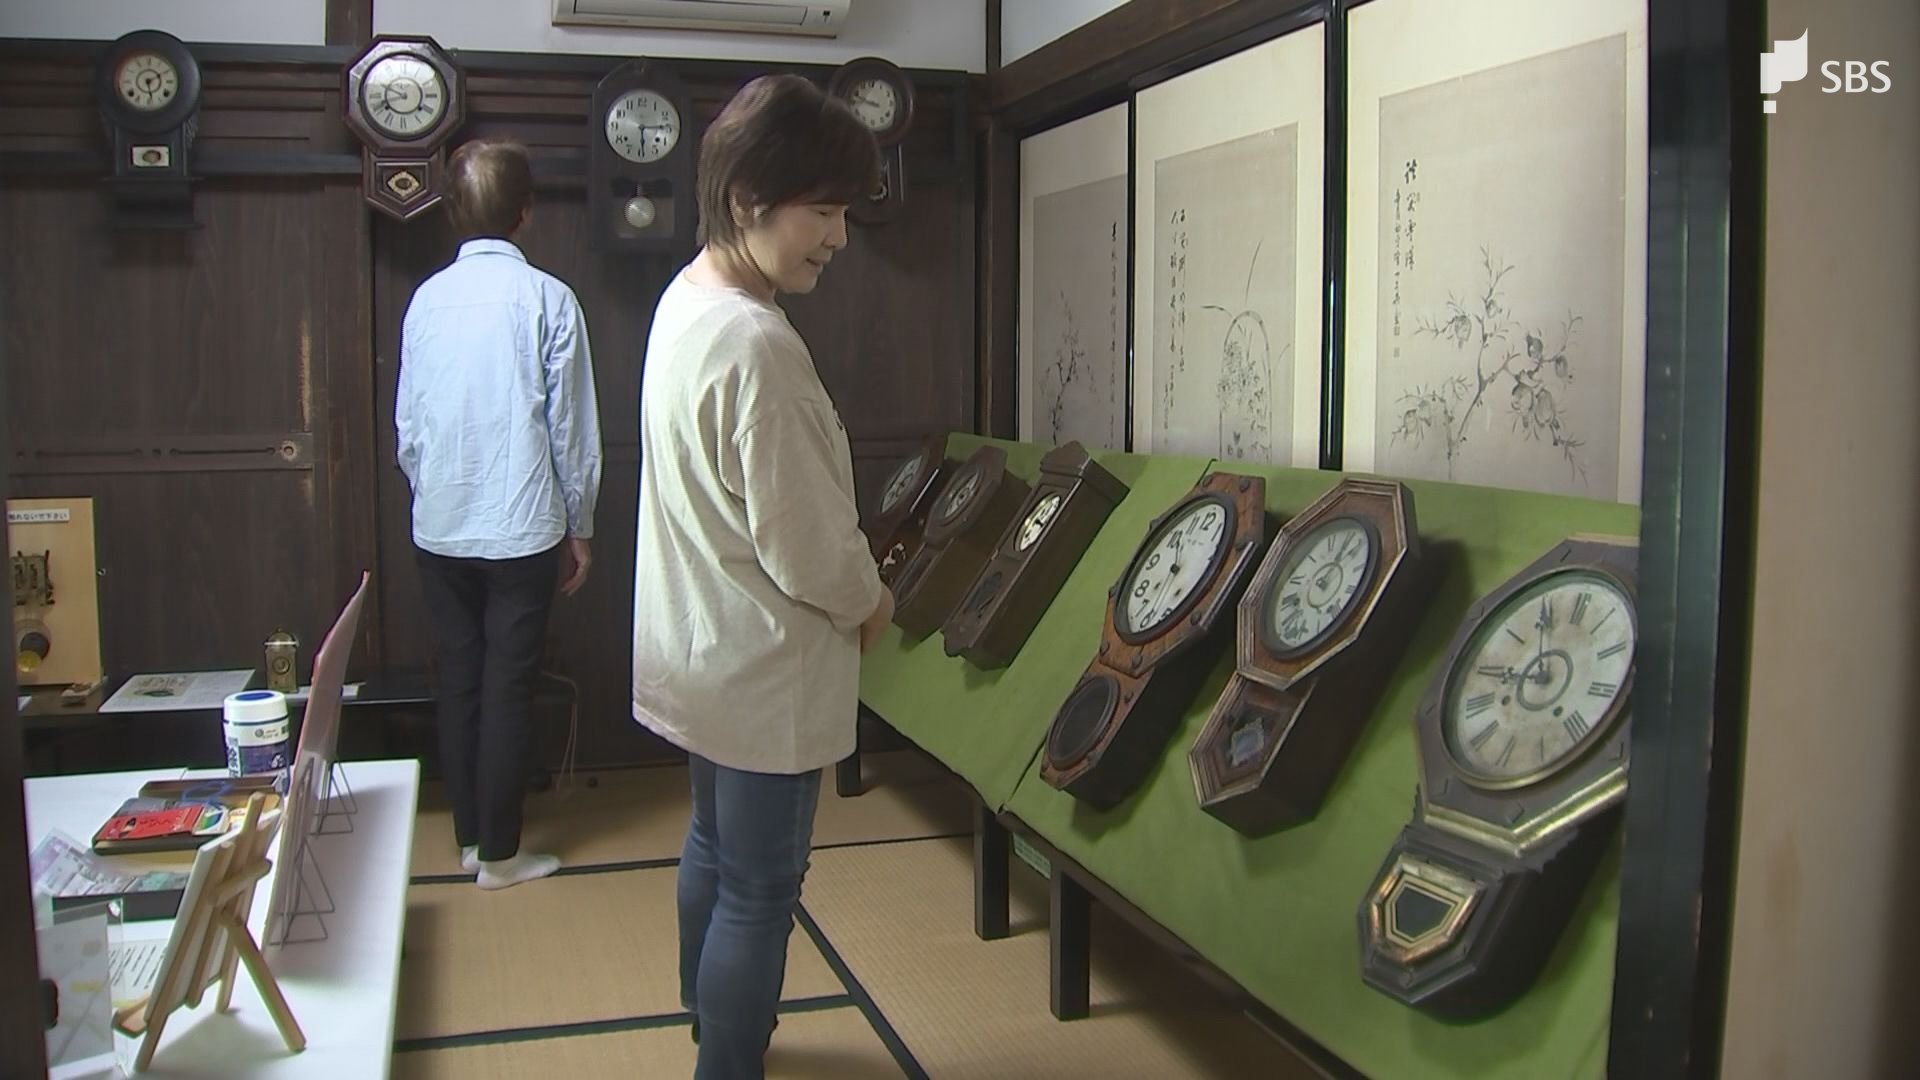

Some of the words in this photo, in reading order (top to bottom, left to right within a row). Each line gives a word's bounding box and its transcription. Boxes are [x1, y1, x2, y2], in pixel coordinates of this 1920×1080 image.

[1186, 513, 1200, 535] 11
[1200, 512, 1216, 531] 12
[1167, 530, 1183, 549] 10
[1146, 553, 1160, 570] 9
[1134, 579, 1150, 598] 8
[1135, 599, 1149, 618] 7
